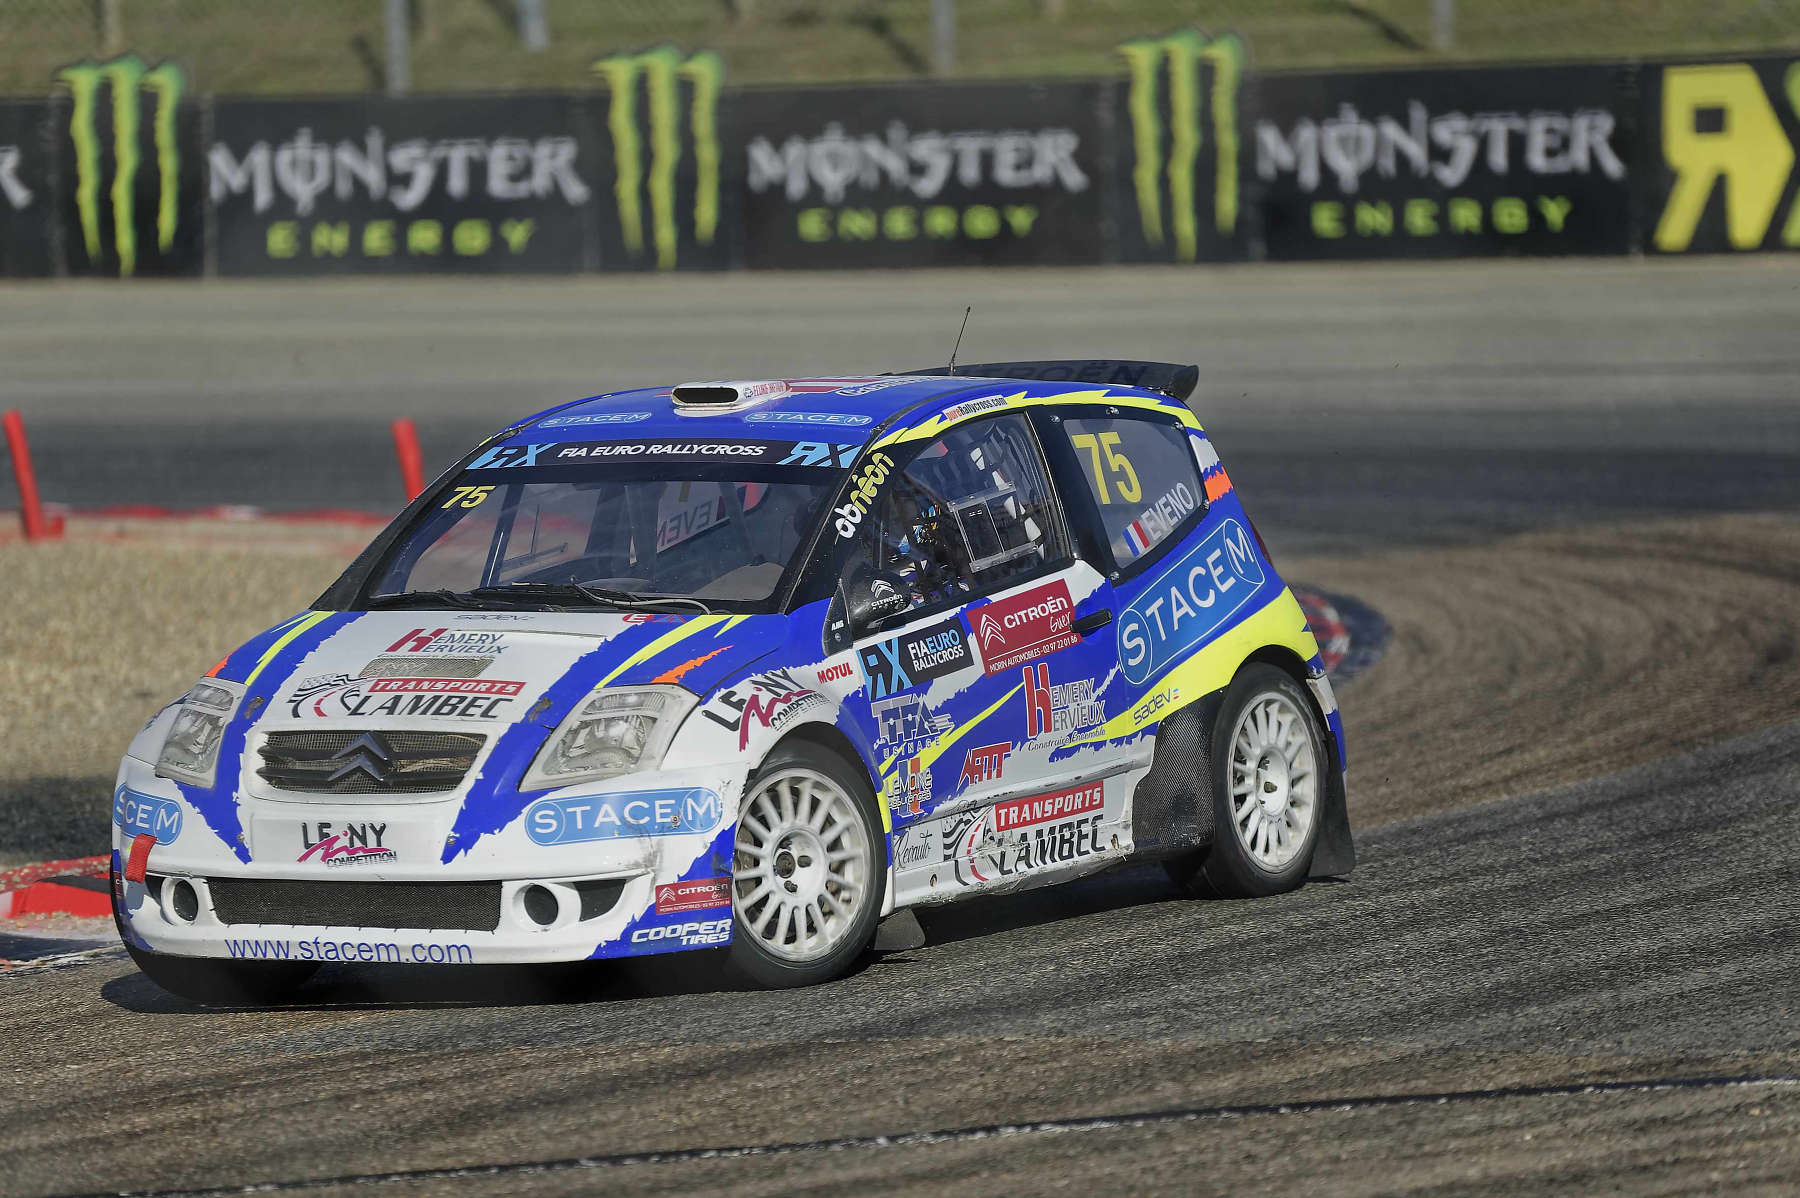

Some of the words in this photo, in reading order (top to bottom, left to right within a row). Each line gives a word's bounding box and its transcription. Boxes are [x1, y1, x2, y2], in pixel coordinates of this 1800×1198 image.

[747, 119, 1090, 203] MONSTER
[1255, 100, 1627, 195] MONSTER
[208, 126, 591, 216] MONSTER
[797, 205, 1040, 243] ENERGY
[1311, 195, 1572, 239] ENERGY
[266, 218, 536, 259] ENERGY
[543, 412, 651, 426] STACEM
[752, 412, 871, 426] STACEM
[557, 445, 590, 458] FIA
[590, 444, 645, 458] EURO
[646, 442, 767, 458] RALLYCROSS
[1072, 431, 1142, 505] 75
[441, 485, 496, 509] 75
[1142, 481, 1195, 541] EVENO
[1123, 528, 1255, 666] STACEM
[817, 663, 853, 684] MOTUL
[912, 645, 965, 672] RALLYCROSS
[374, 681, 521, 694] TRANSPORTS
[346, 694, 514, 719] LAMBEC
[1133, 688, 1171, 725] sadev
[883, 735, 942, 760] USINAGE
[534, 798, 718, 834] STACEM
[998, 788, 1102, 827] TRANSPORTS
[631, 918, 732, 943] COOPER
[679, 931, 731, 946] TIRES
[225, 937, 474, 964] www.stacem.com
